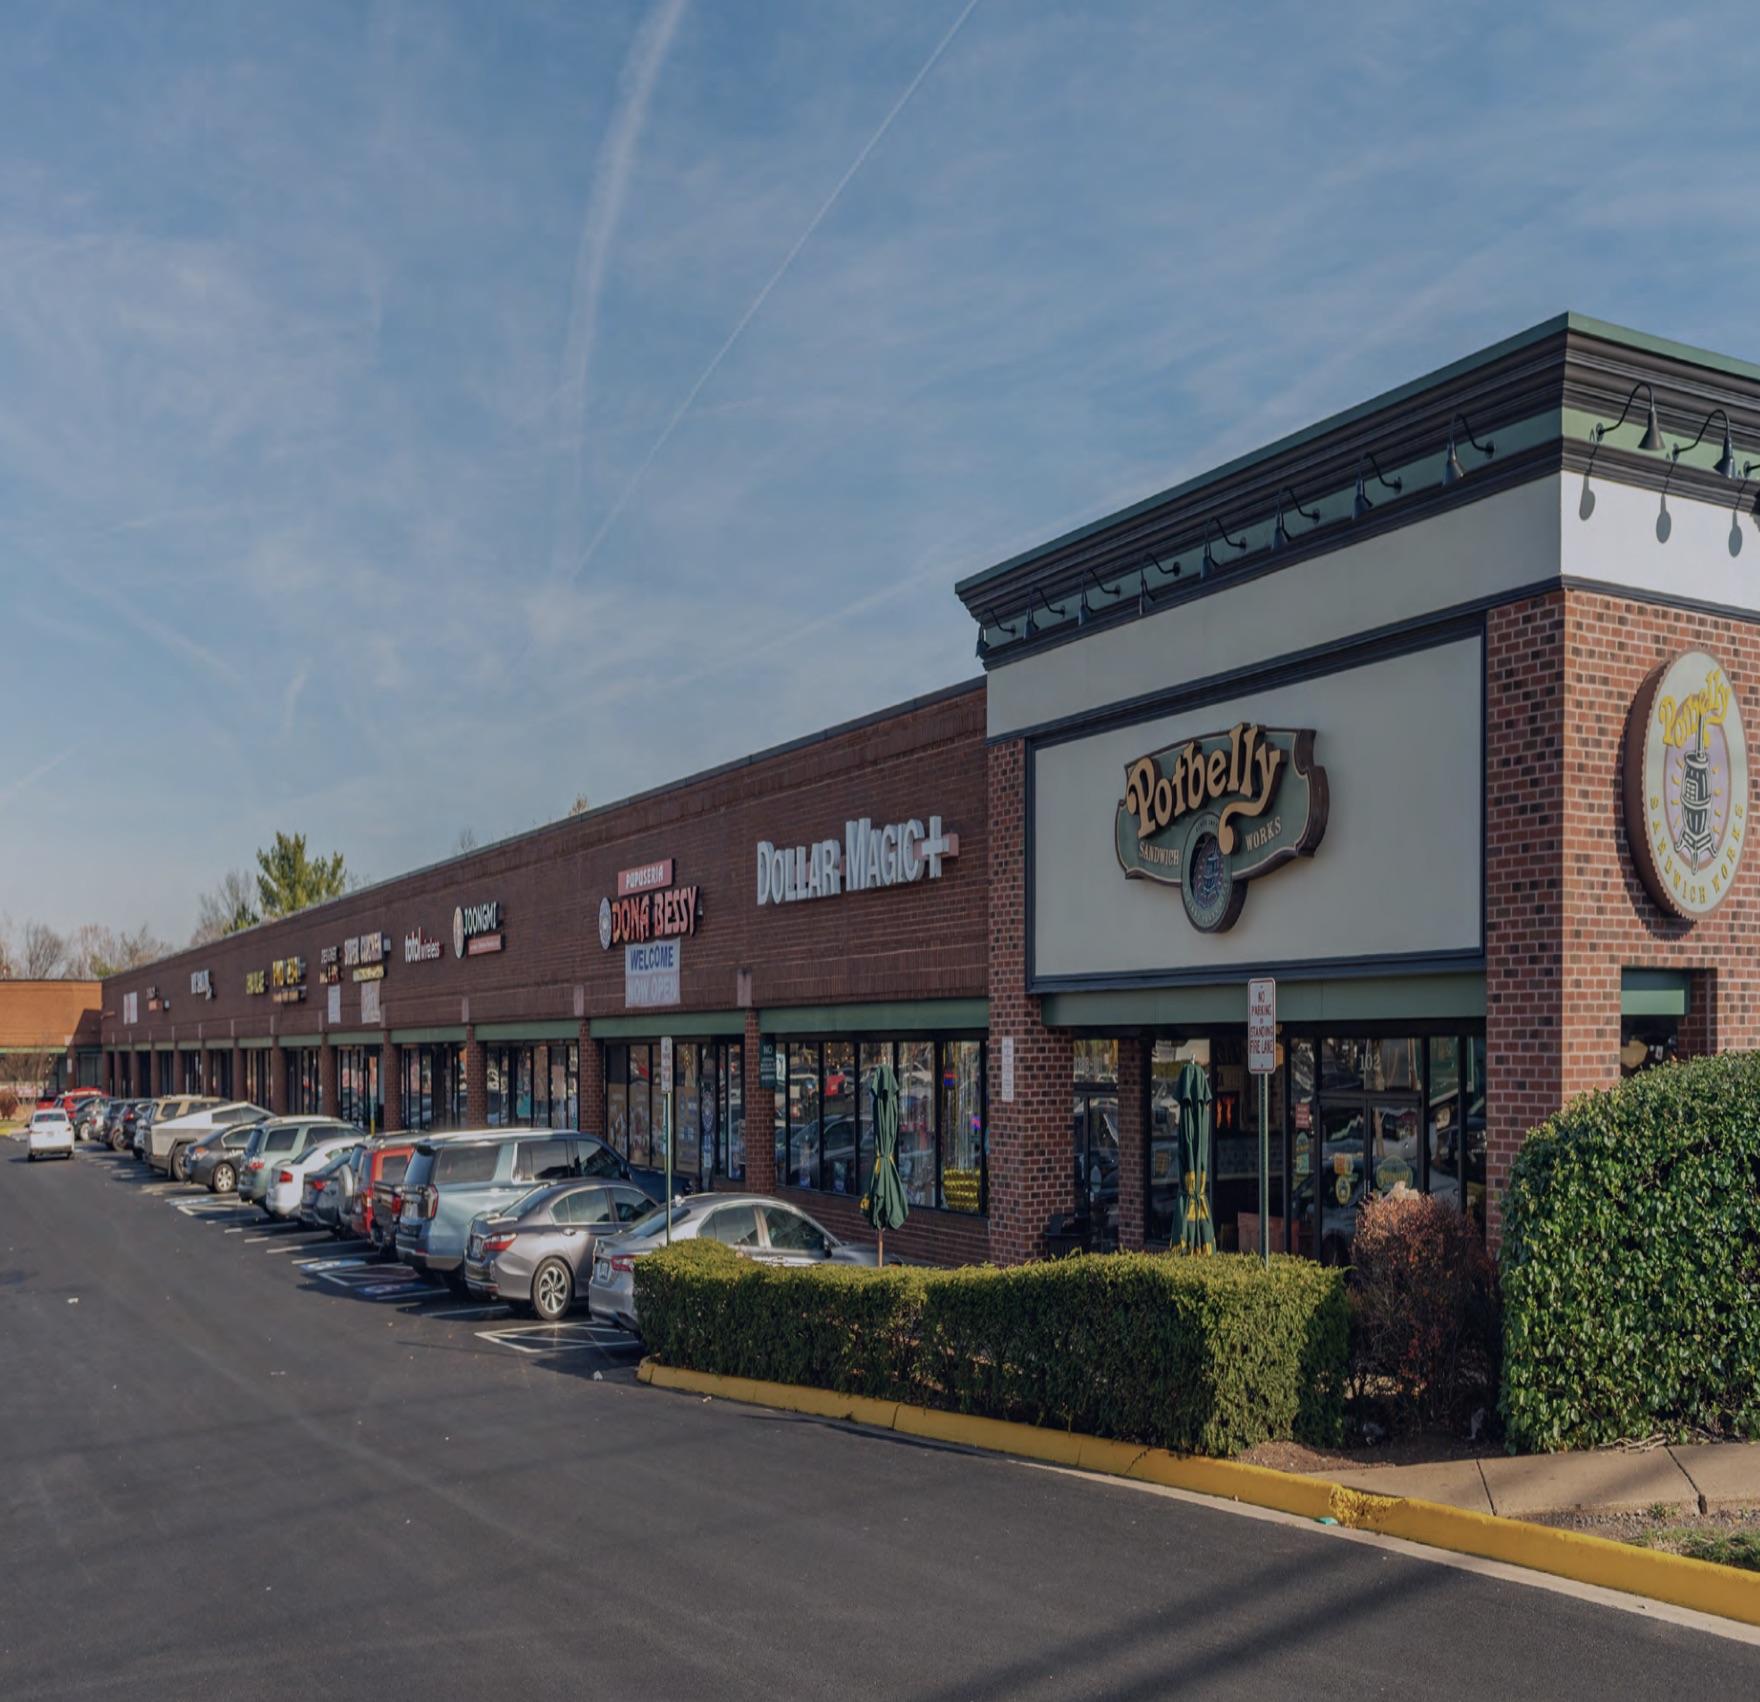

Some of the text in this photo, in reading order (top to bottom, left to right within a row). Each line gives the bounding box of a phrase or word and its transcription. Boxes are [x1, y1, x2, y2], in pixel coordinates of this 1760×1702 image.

[1127, 723, 1281, 855] Potbelly
[1139, 842, 1179, 865] SANDWICH
[1246, 816, 1282, 851] WORKS
[1651, 797, 1744, 904] SANDWICH WORKS
[757, 839, 842, 906] DOLLAR
[464, 902, 497, 935] JOONGMI
[654, 885, 697, 937] BESSY
[405, 927, 421, 963] total
[630, 944, 674, 971] WELCOME
[650, 975, 678, 1001] OPEN
[1257, 991, 1265, 1003] NO
[1251, 1004, 1272, 1017] PARKING
[1261, 1040, 1273, 1055] LANE
[1358, 1053, 1382, 1072] 102
